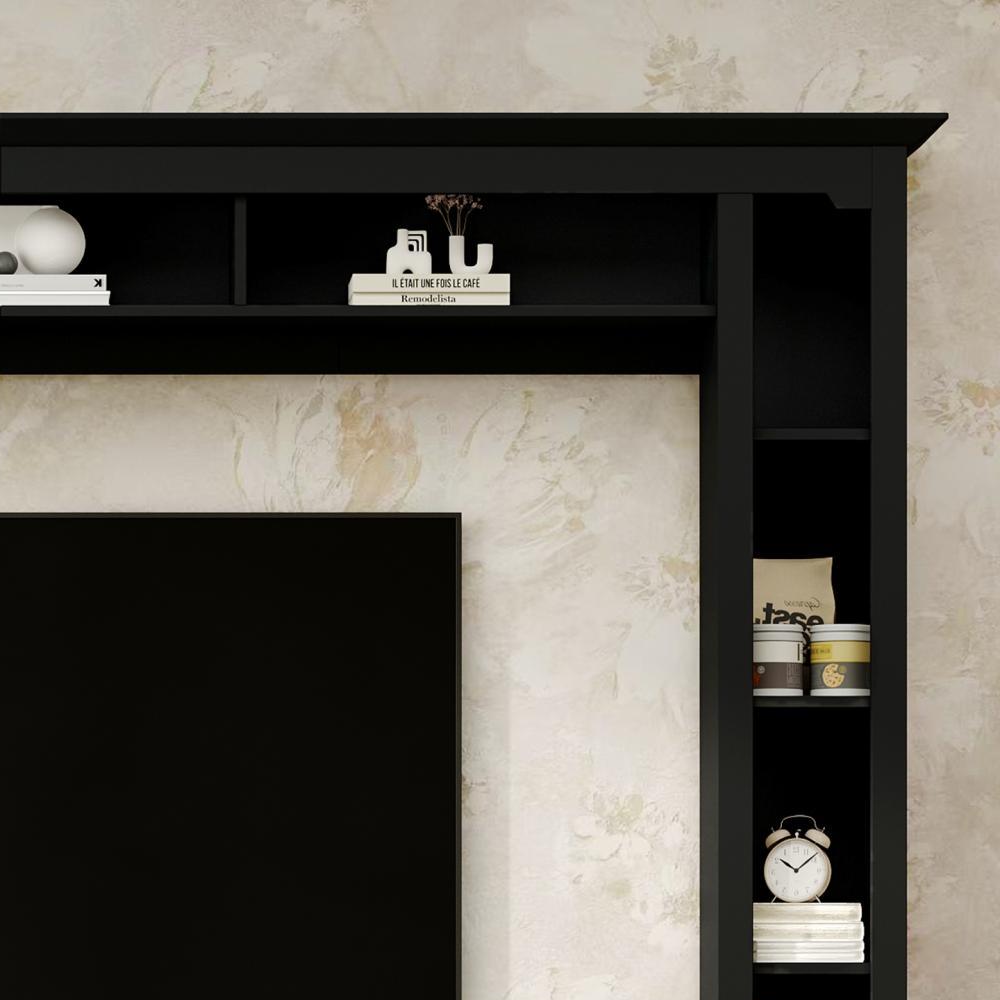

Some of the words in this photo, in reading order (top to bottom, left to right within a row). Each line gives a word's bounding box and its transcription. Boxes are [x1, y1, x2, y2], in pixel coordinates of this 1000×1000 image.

[392, 278, 399, 288] IL
[421, 278, 435, 288] UNE
[436, 278, 451, 288] FOIS
[453, 278, 461, 288] LE
[401, 294, 456, 303] Remodelista
